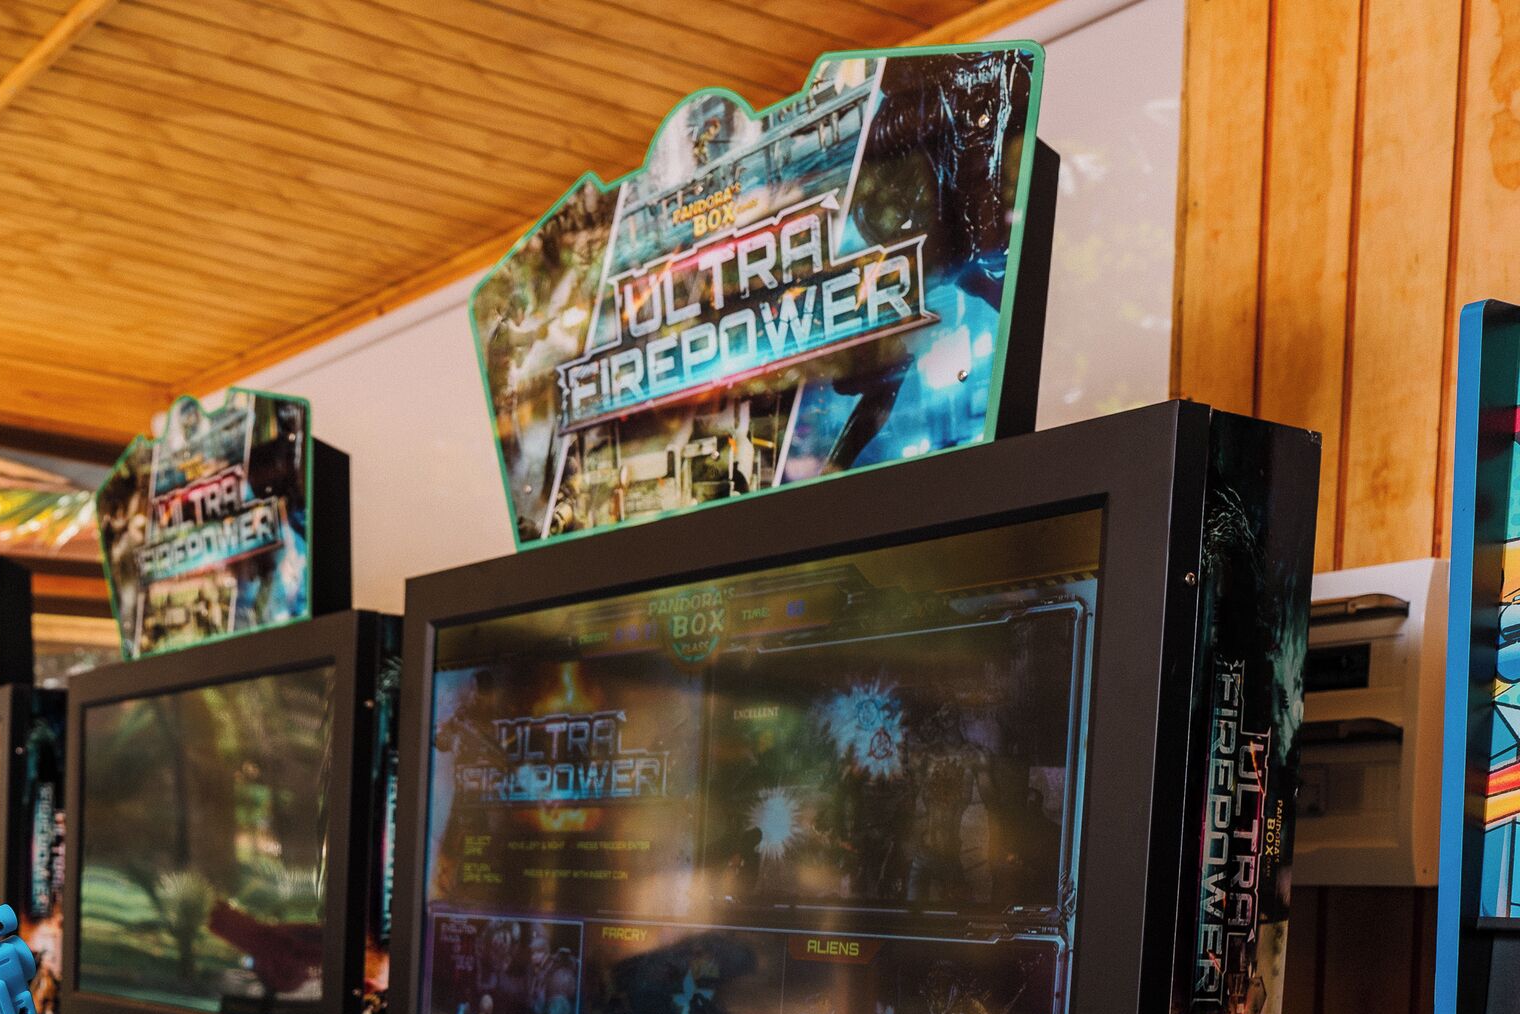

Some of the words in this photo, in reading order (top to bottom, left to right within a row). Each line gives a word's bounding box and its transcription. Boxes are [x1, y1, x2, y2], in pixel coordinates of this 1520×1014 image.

[693, 201, 737, 238] BOX
[622, 214, 824, 338] ULTRA
[568, 255, 912, 419] FIREPOWER
[648, 587, 736, 617] PANDORA'S
[672, 608, 725, 639] BOX
[500, 719, 617, 760] ULTRA
[1195, 673, 1241, 992] FIREPOWER
[1227, 743, 1265, 926] ULTRA
[1265, 818, 1276, 856] BOX
[807, 939, 860, 957] ALIENS
